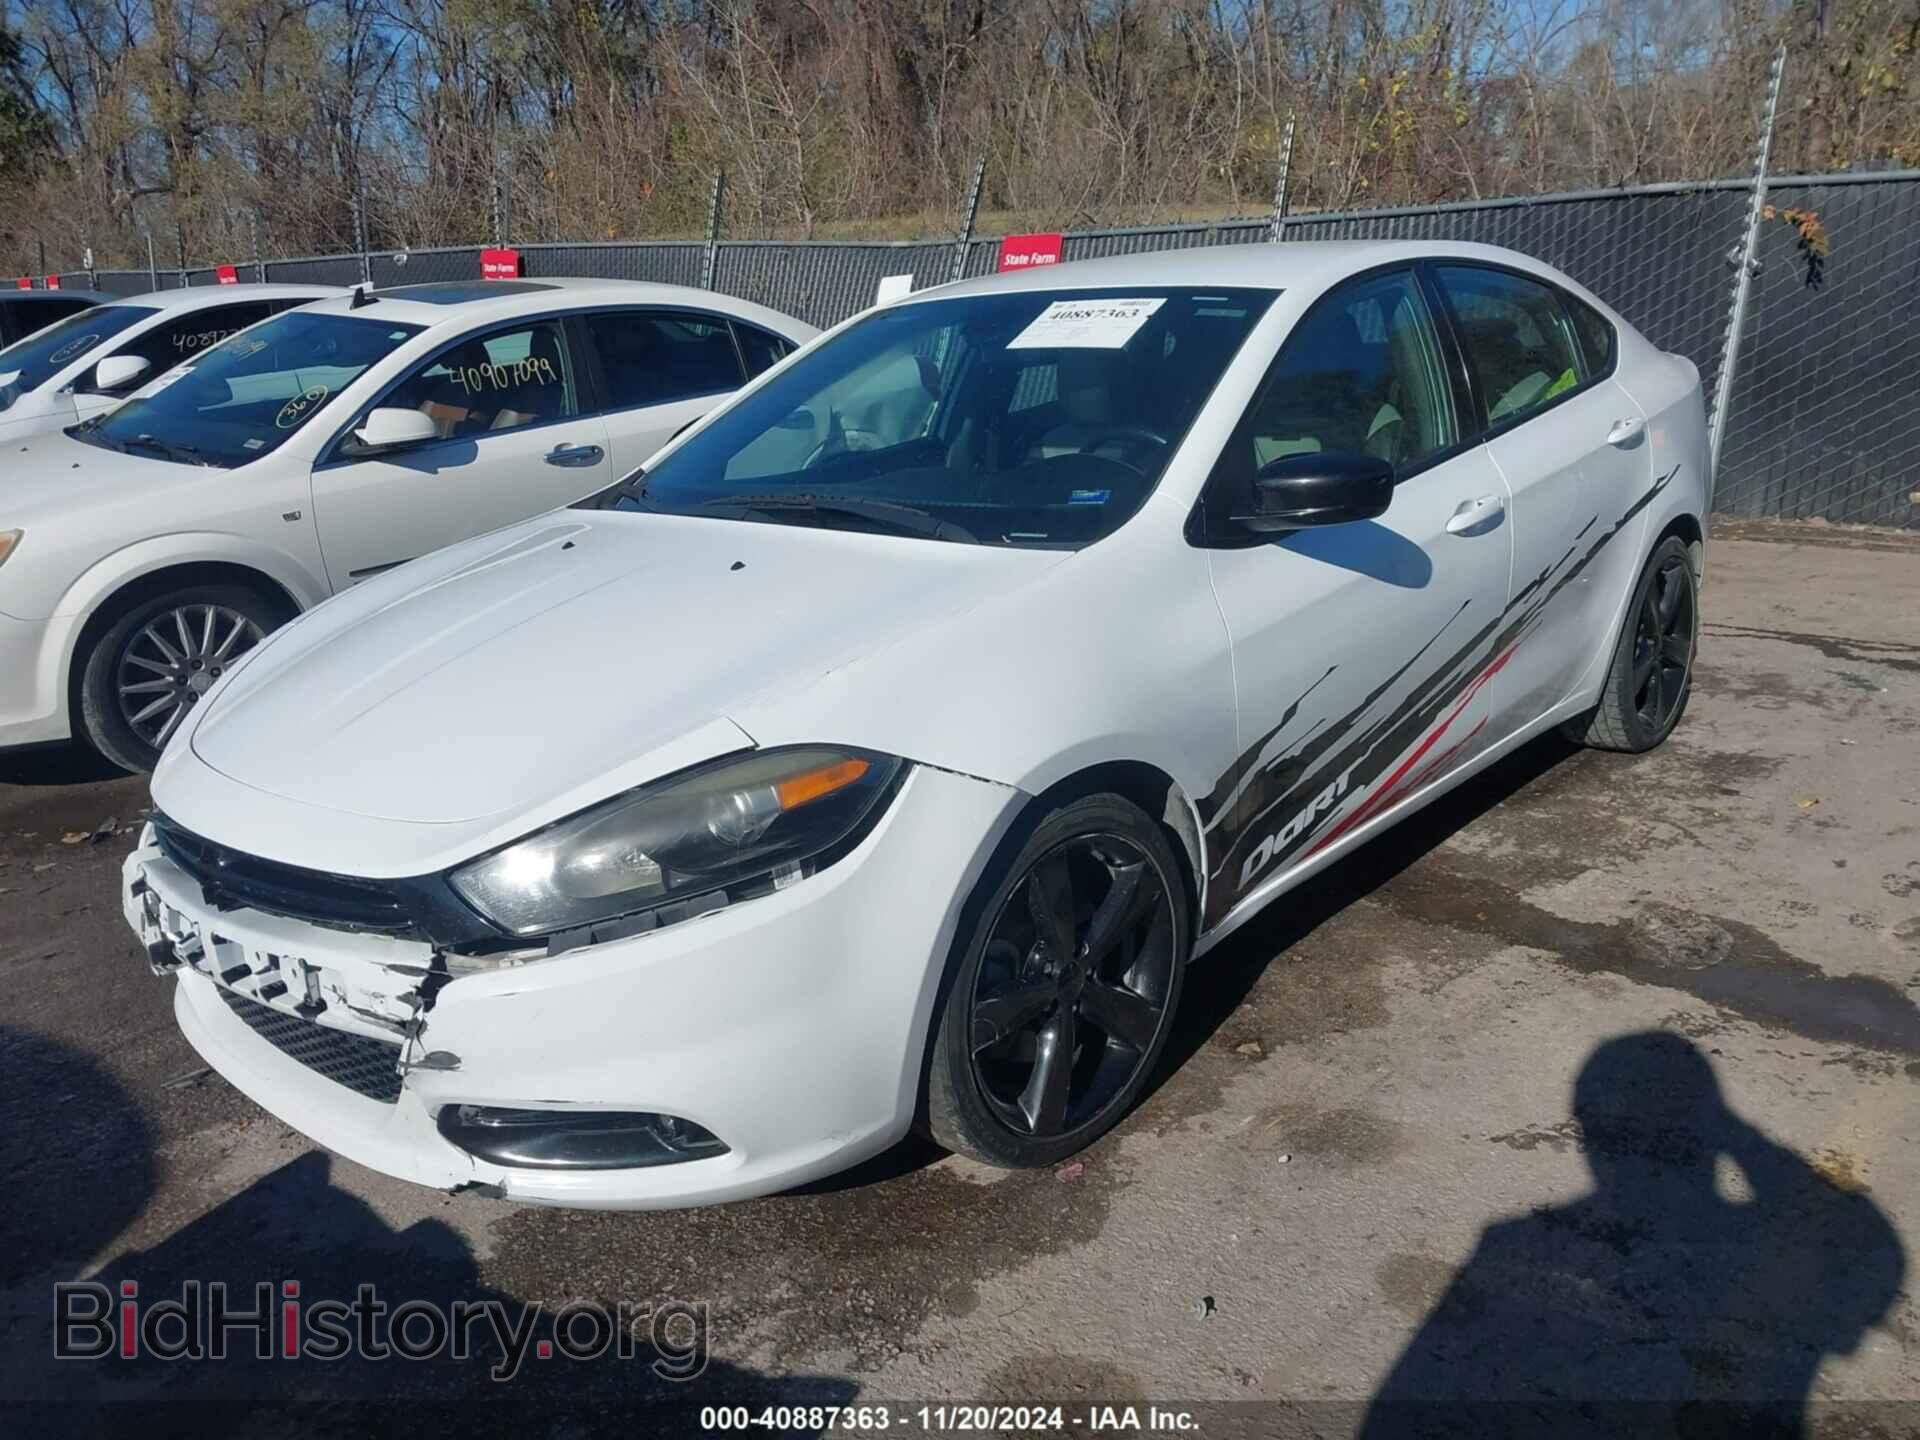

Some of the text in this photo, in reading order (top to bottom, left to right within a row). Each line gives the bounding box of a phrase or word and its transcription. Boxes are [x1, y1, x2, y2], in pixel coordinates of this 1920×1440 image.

[1004, 252, 1057, 266] State Farm
[1050, 308, 1140, 320] 40887363
